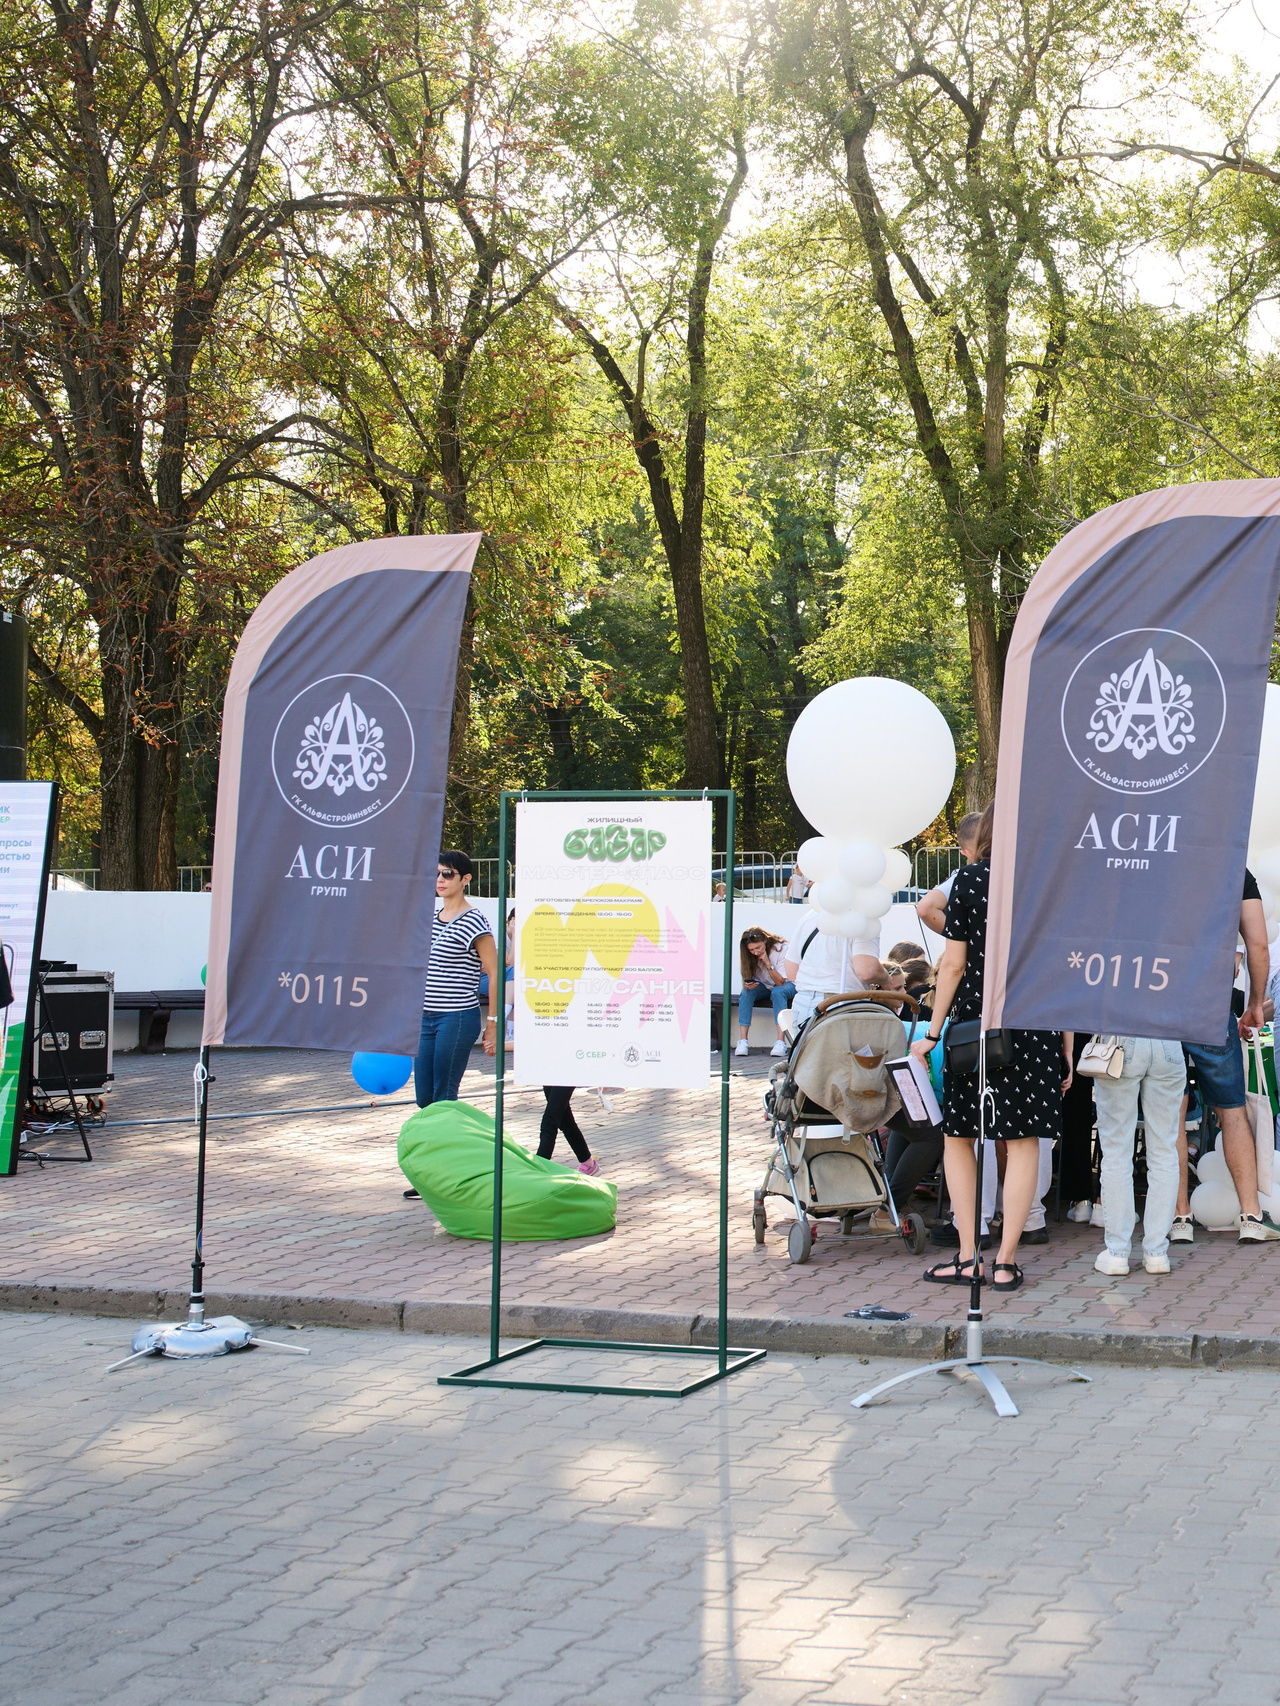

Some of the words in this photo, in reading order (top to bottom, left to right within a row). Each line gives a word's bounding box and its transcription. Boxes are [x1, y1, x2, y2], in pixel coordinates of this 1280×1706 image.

[1084, 758, 1096, 770] ГК
[1094, 763, 1190, 788] АЛЬФАСТРОЙИНВЕСТ
[291, 794, 302, 806] ГК
[301, 799, 383, 822] АЛЬФАСТРОЙИНВЕСТ
[1074, 812, 1182, 852] АСИ
[285, 844, 376, 881] АСИ
[1106, 858, 1150, 870] ГРУПП
[521, 865, 706, 880] МАСТЕР-КЛАСС
[311, 886, 347, 897] ГРУПП
[521, 977, 705, 995] РАСПИСАНИЕ
[586, 1051, 606, 1059] СБЕР
